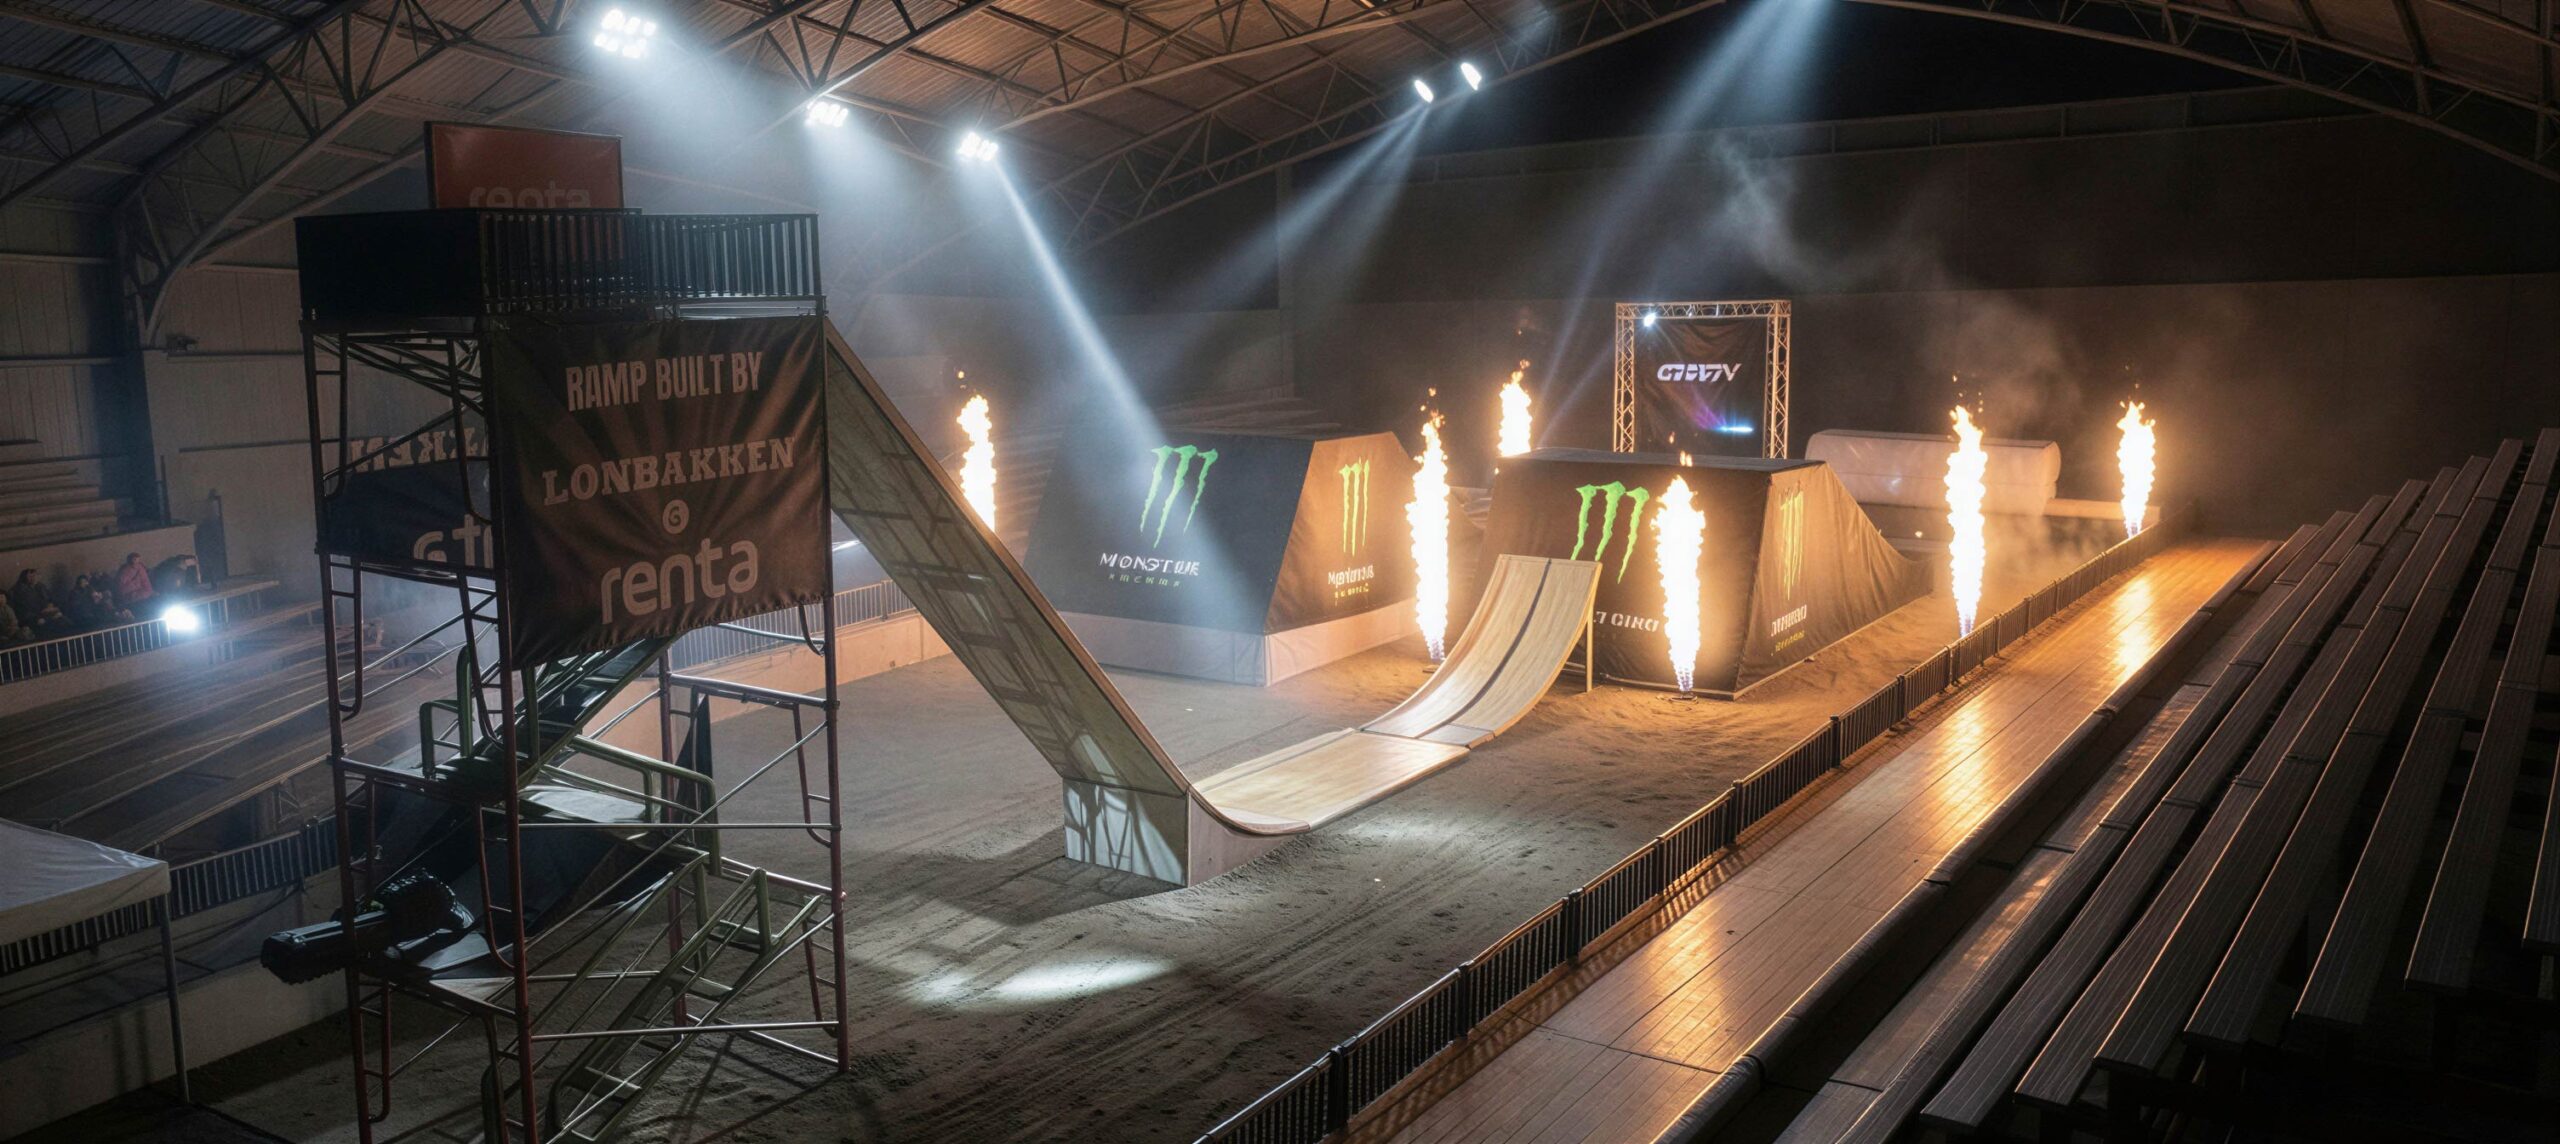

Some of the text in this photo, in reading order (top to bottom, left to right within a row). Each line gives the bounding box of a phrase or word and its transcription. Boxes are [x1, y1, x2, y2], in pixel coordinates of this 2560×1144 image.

[566, 352, 762, 412] RAMP BUILT BY
[542, 437, 796, 505] LONBAKKEN
[601, 538, 758, 624] renta
